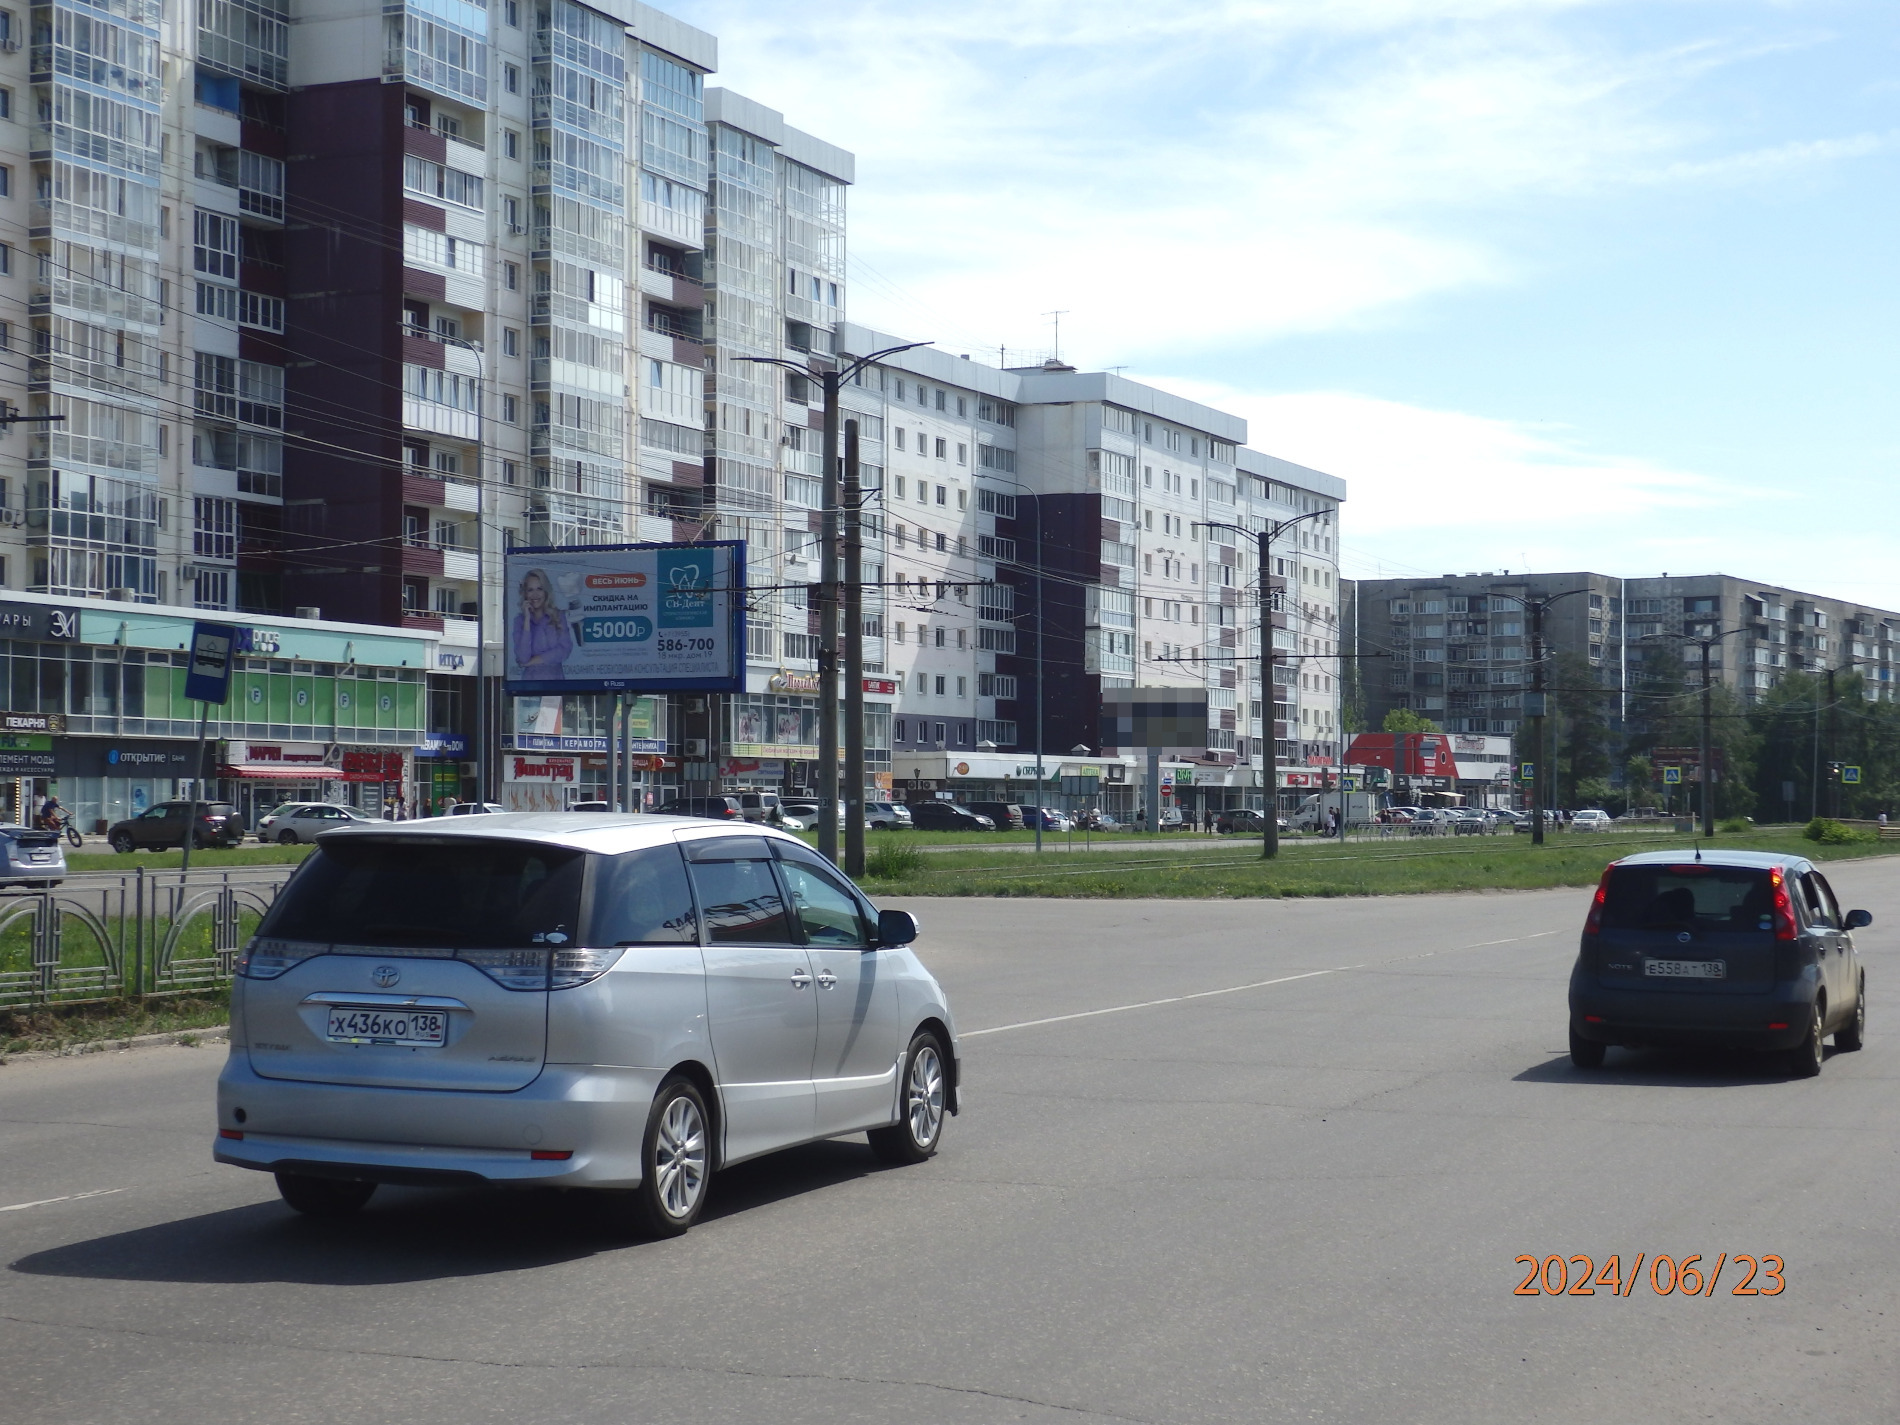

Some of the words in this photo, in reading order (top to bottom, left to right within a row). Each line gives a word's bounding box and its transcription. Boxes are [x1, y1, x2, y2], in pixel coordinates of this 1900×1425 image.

[592, 577, 613, 586] ВЕСЬ
[614, 576, 639, 585] ИЮНЬ
[592, 594, 625, 602] СКИДКА
[626, 593, 639, 601] НА
[583, 602, 648, 612] ИМПЛАНТАЦИЮ
[0, 613, 31, 627] АРЫ
[253, 630, 280, 645] price
[656, 636, 715, 651] 586-700
[657, 650, 667, 659] 18
[668, 651, 686, 660] мкр.
[686, 651, 702, 660] дом
[704, 650, 713, 659] 19
[610, 680, 625, 688] Russ
[6, 716, 46, 729] ПЕКАРНЯ
[532, 738, 554, 747] ПЛИТКА
[31, 755, 55, 765] МОДЫ
[120, 751, 166, 765] открытие
[171, 754, 186, 762] БАНК
[1649, 962, 1698, 976] Е558АТ
[1701, 963, 1720, 974] 138
[335, 1013, 407, 1036] Х436КО
[411, 1015, 439, 1031] 138
